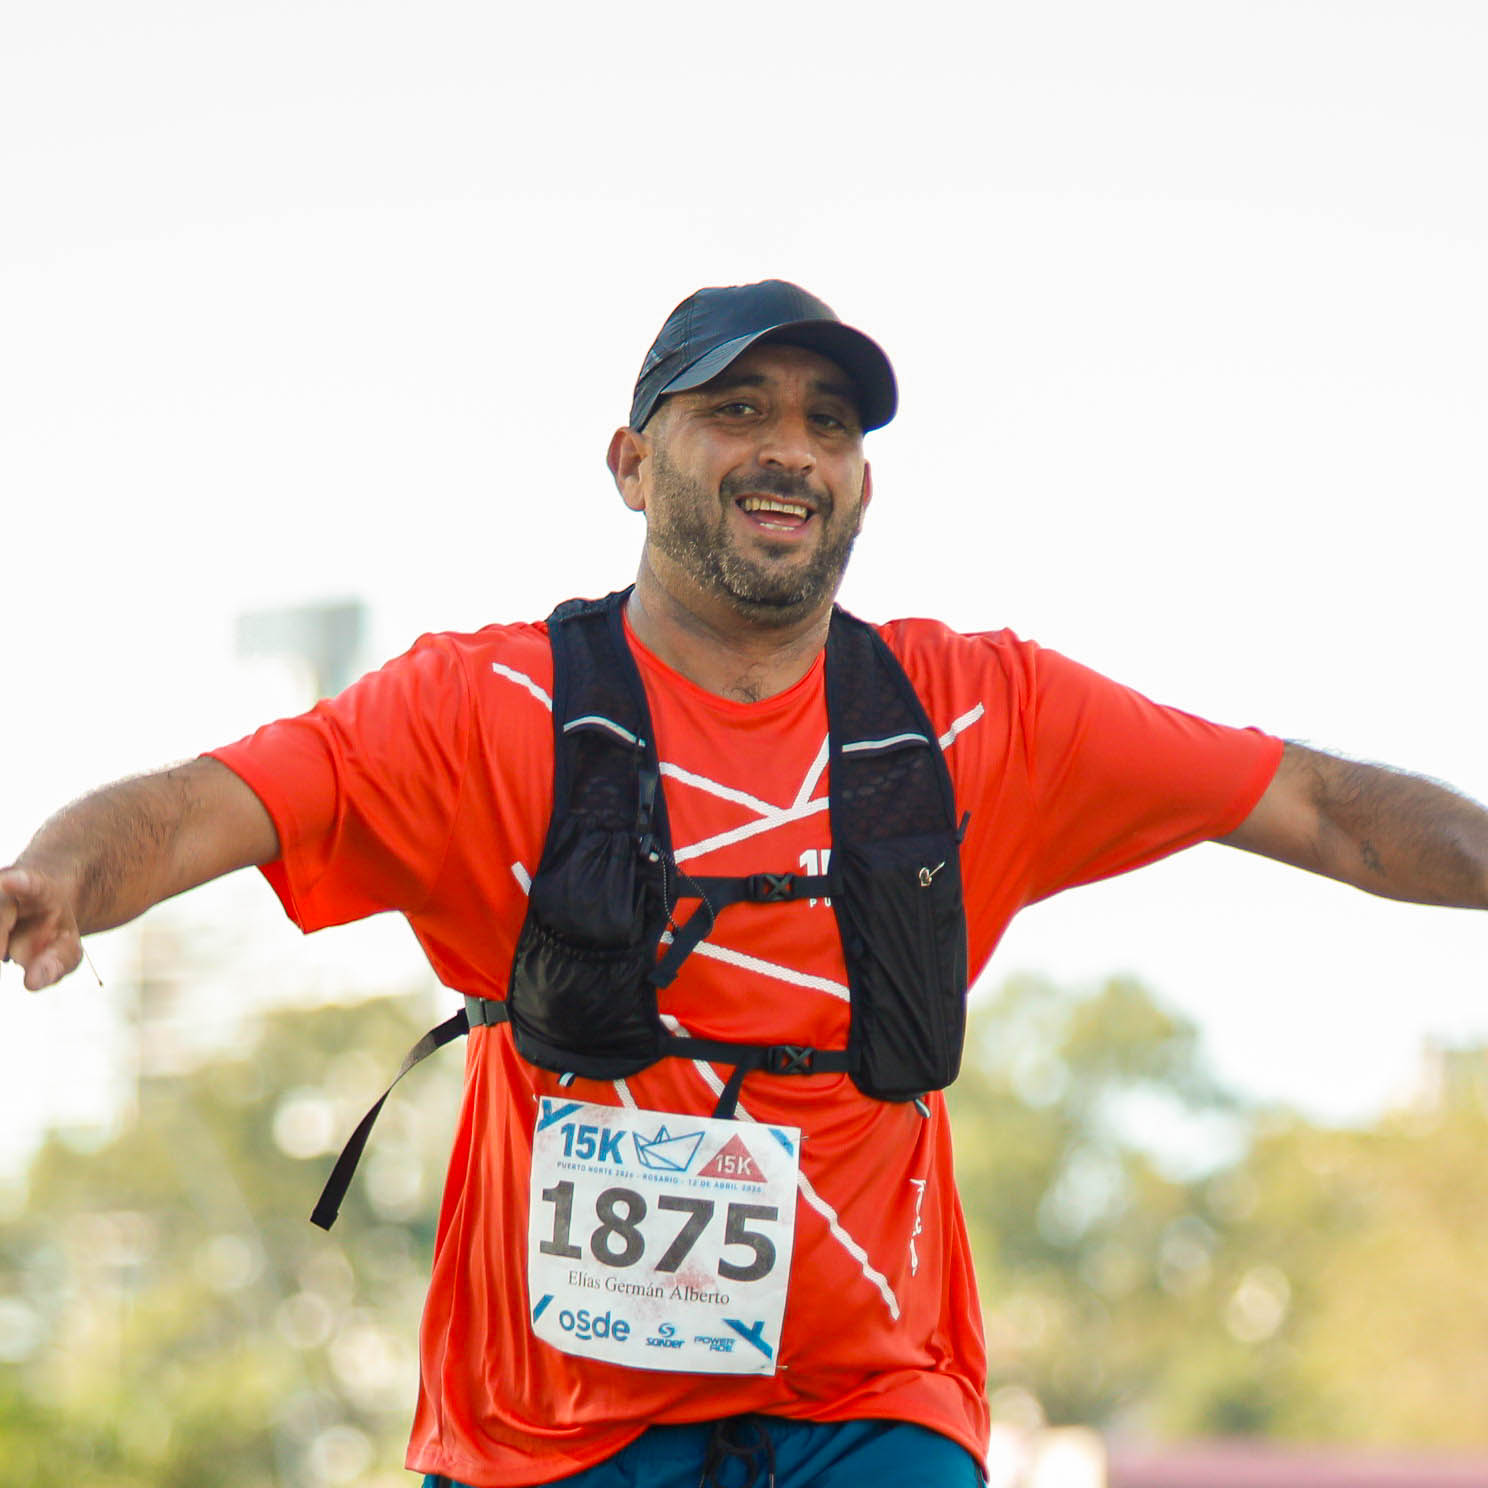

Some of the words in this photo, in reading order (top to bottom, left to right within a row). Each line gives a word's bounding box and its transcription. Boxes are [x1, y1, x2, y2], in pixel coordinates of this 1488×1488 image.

[560, 1122, 628, 1165] 15K
[557, 1161, 586, 1172] PUERTO
[588, 1166, 613, 1177] NORTE
[642, 1173, 679, 1184] ROSARIO
[688, 1178, 697, 1187] 12
[699, 1180, 710, 1188] DE
[714, 1180, 738, 1191] ABRIL
[715, 1154, 753, 1176] 15K
[539, 1179, 779, 1282] 1875
[568, 1270, 601, 1290] Elías
[605, 1276, 664, 1299] Germán
[670, 1284, 730, 1305] Alberto
[559, 1309, 631, 1341] osde
